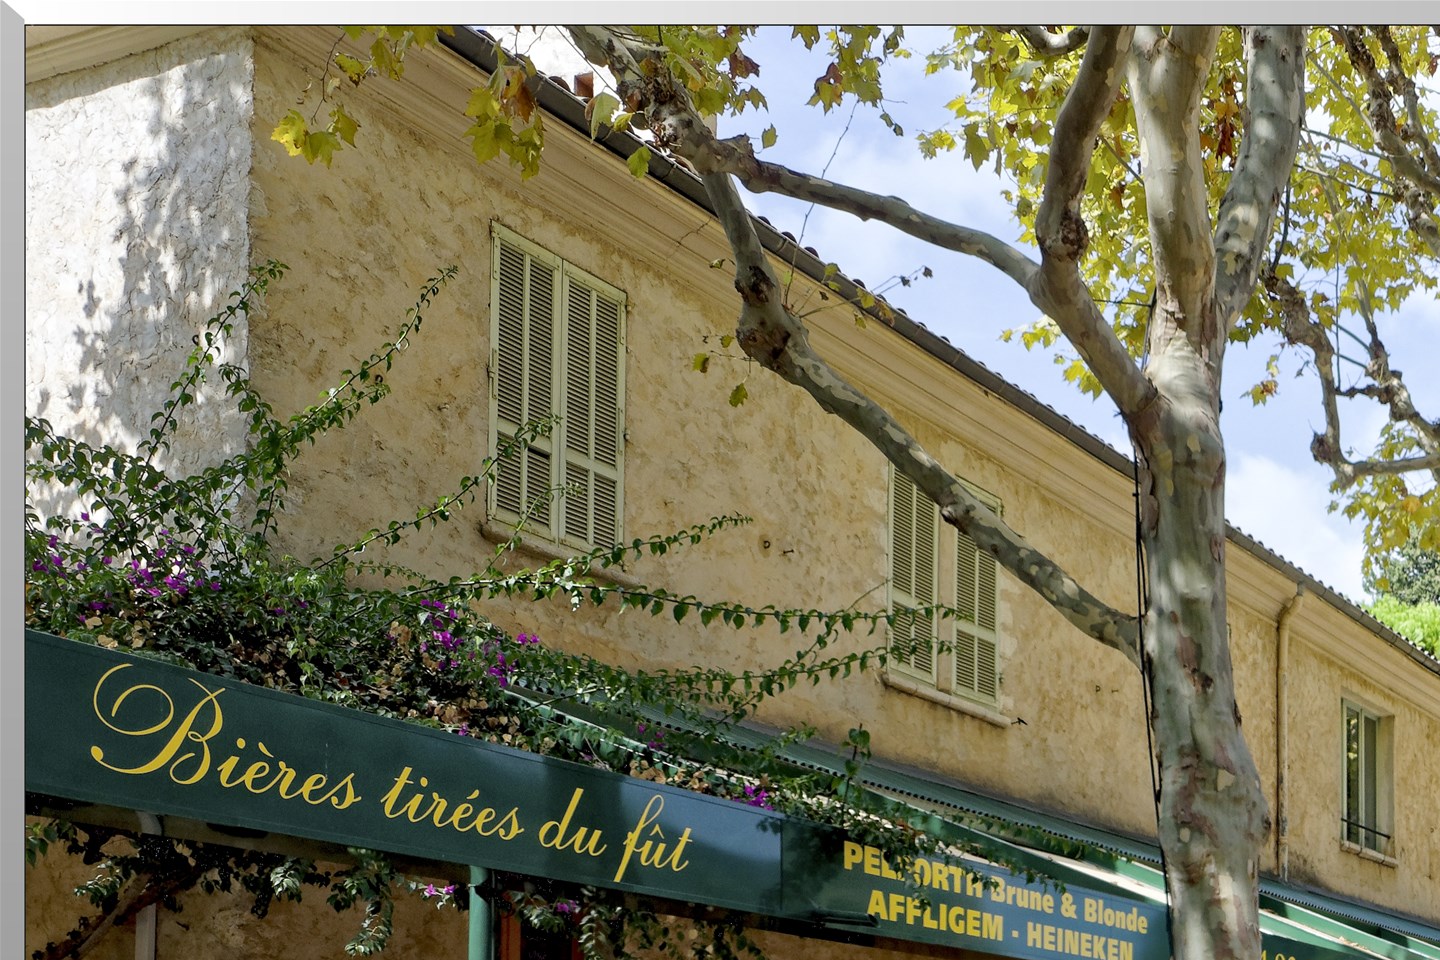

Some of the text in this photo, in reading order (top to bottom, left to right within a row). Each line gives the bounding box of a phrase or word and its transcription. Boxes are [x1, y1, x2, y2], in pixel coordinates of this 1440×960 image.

[90, 662, 694, 883] Bières tirées du fût
[843, 840, 1149, 935] PELORTH Brune & Blonde
[866, 889, 1004, 942] AFFLIGEM
